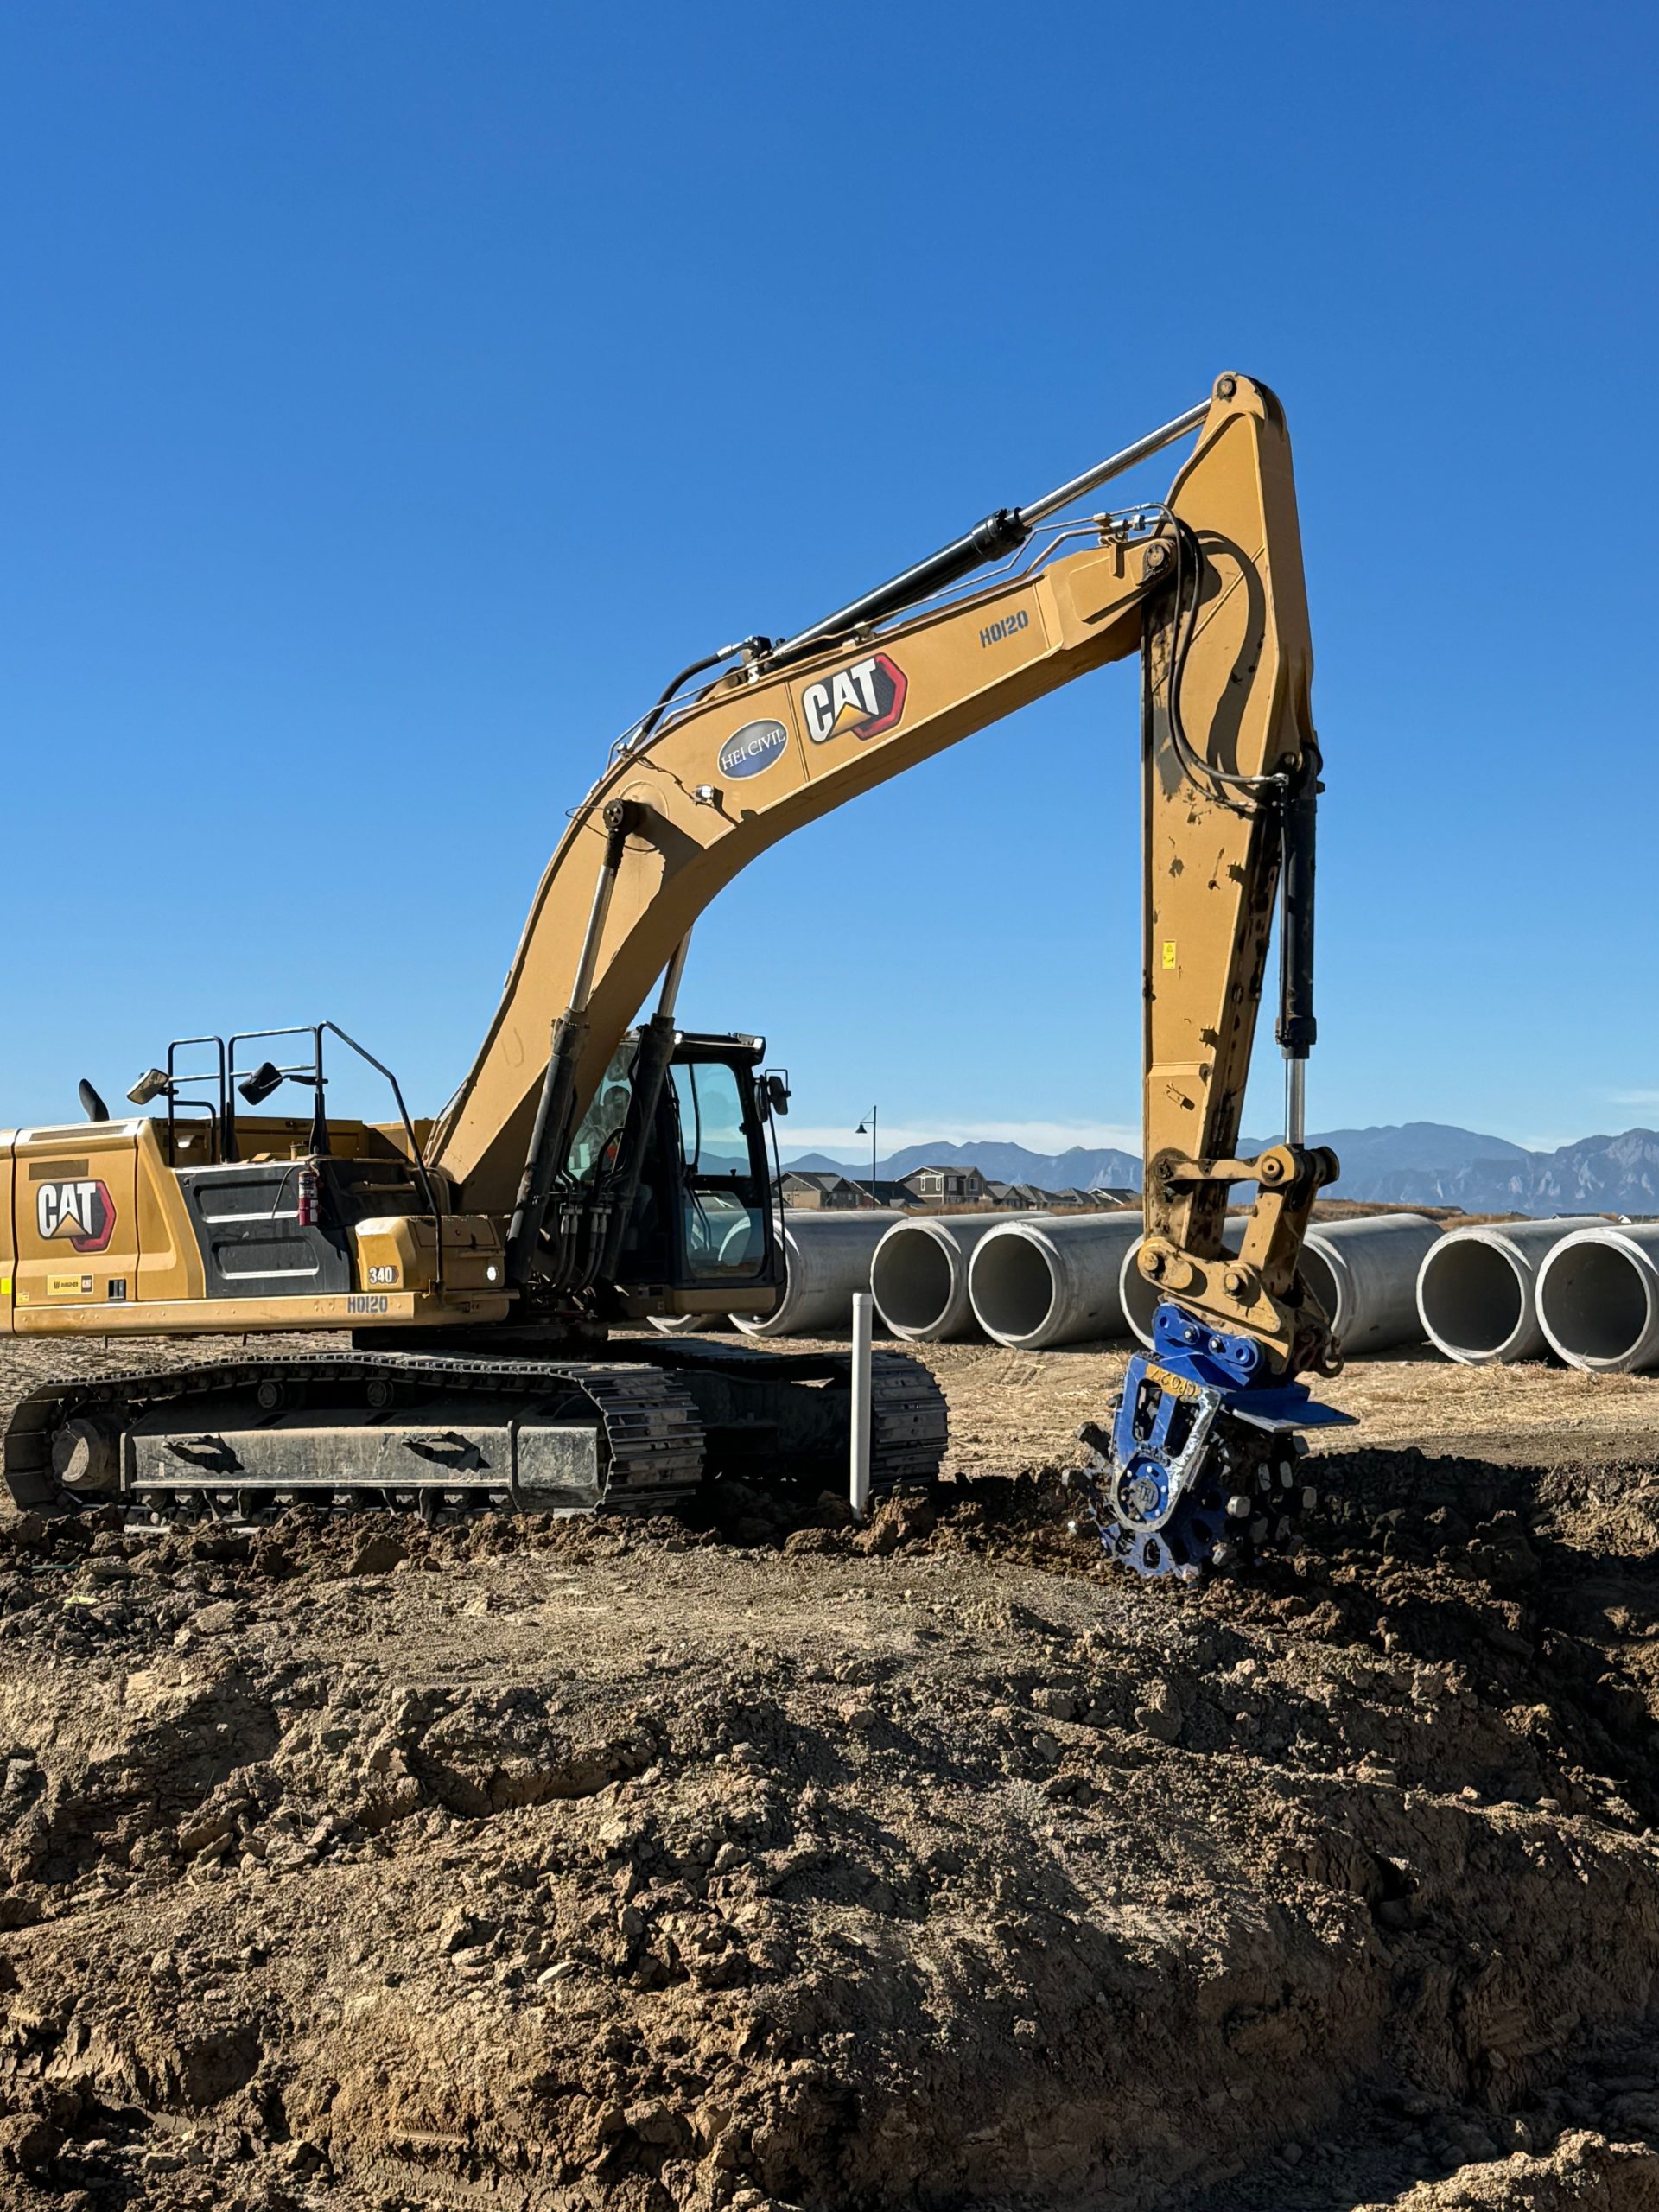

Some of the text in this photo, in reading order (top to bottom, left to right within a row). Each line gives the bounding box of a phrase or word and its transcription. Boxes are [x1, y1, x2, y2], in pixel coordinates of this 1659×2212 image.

[803, 658, 880, 742] CAT
[721, 729, 785, 771] HEI CIVIL
[38, 1181, 96, 1237] CAT
[369, 1266, 393, 1284] 340
